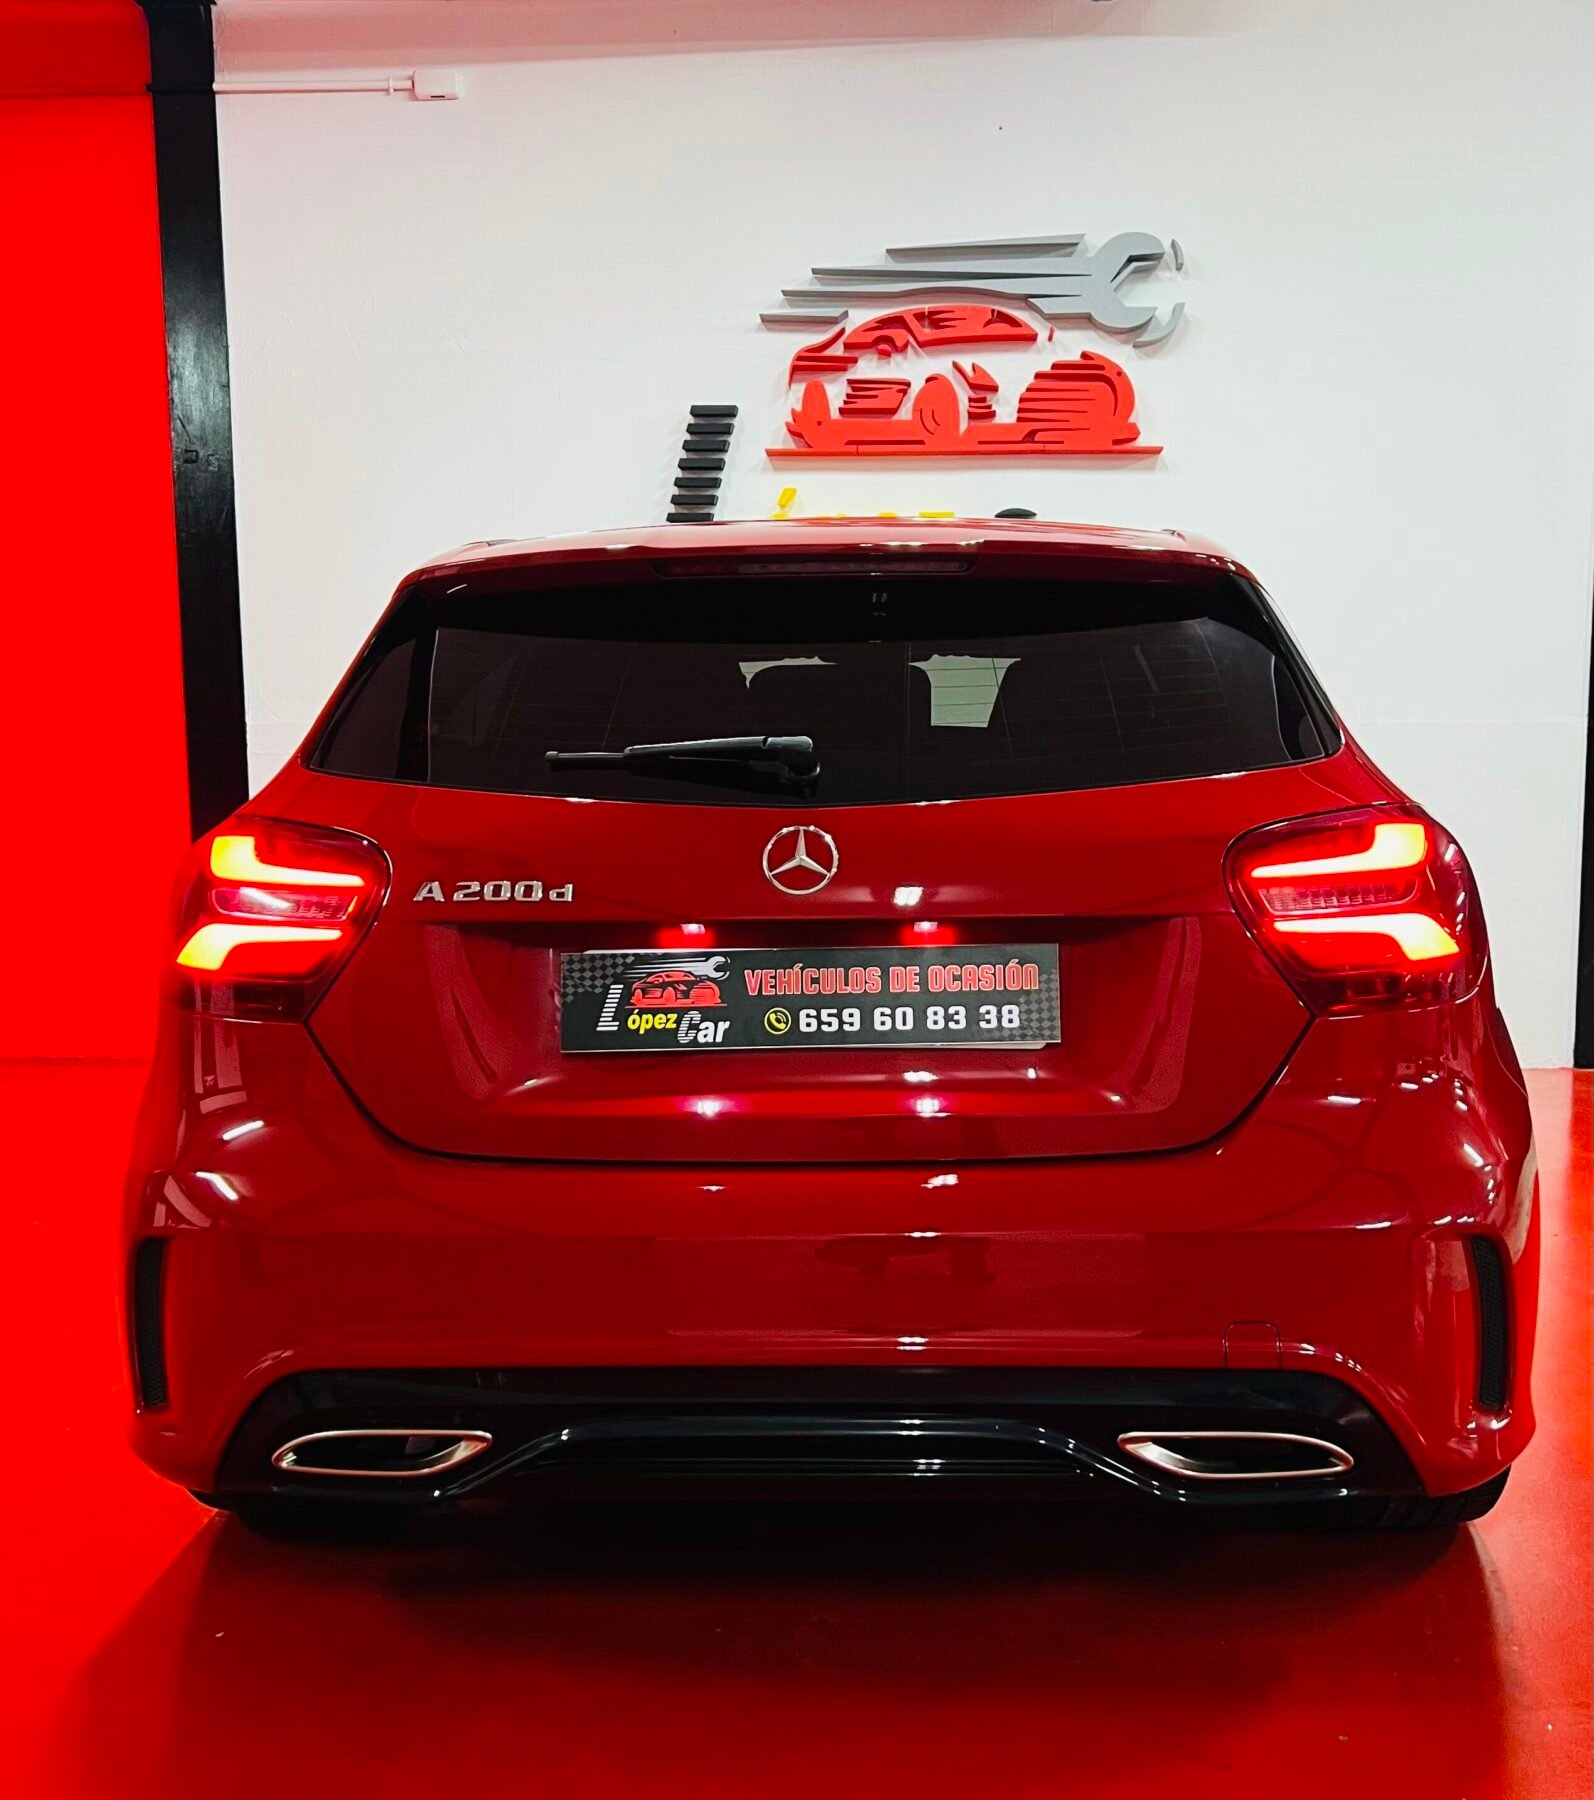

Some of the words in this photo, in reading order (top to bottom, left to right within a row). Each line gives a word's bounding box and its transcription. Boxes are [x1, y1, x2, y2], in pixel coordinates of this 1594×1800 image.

[413, 881, 445, 902] A
[744, 963, 882, 996] VEHÍCULOS
[889, 966, 920, 992] DE
[928, 959, 1039, 992] OCASIÓN
[677, 1011, 730, 1043] Car
[799, 1008, 861, 1032] 659
[873, 1006, 914, 1031] 60
[926, 1005, 967, 1030] 83
[979, 1004, 1020, 1029] 38
